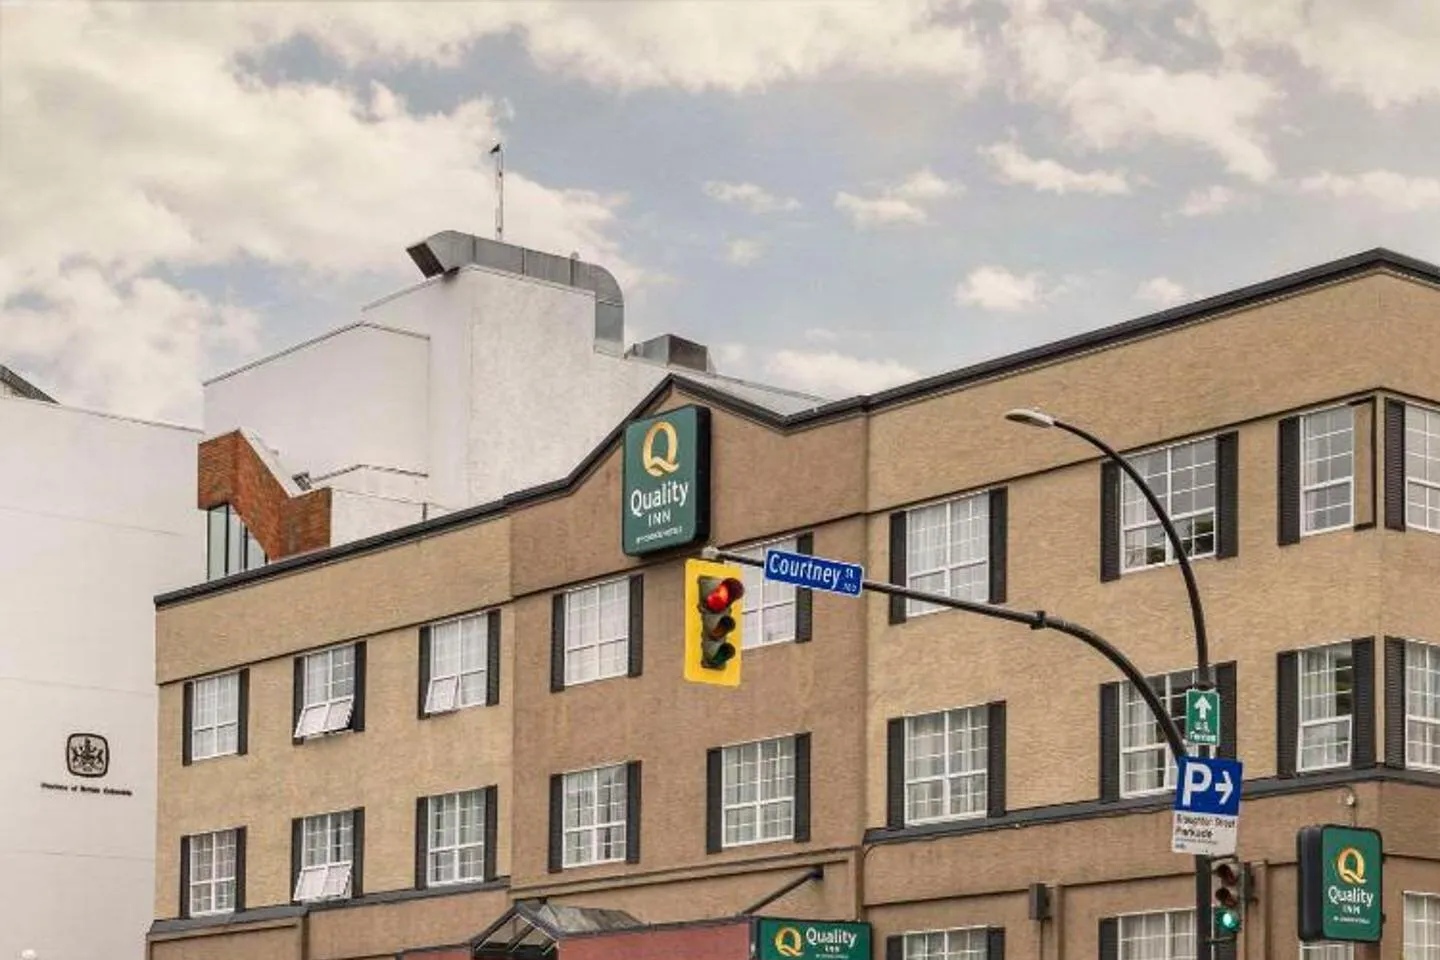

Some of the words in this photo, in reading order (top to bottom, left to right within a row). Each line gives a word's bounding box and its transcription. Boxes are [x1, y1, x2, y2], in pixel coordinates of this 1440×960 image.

[643, 421, 680, 476] Q
[631, 480, 688, 517] Quality
[648, 509, 671, 527] INN
[769, 553, 842, 590] Courtney
[1182, 762, 1212, 806] P
[1338, 847, 1367, 885] Q
[1328, 886, 1374, 908] Quality
[775, 927, 804, 957] Q
[806, 927, 857, 948] Quality
